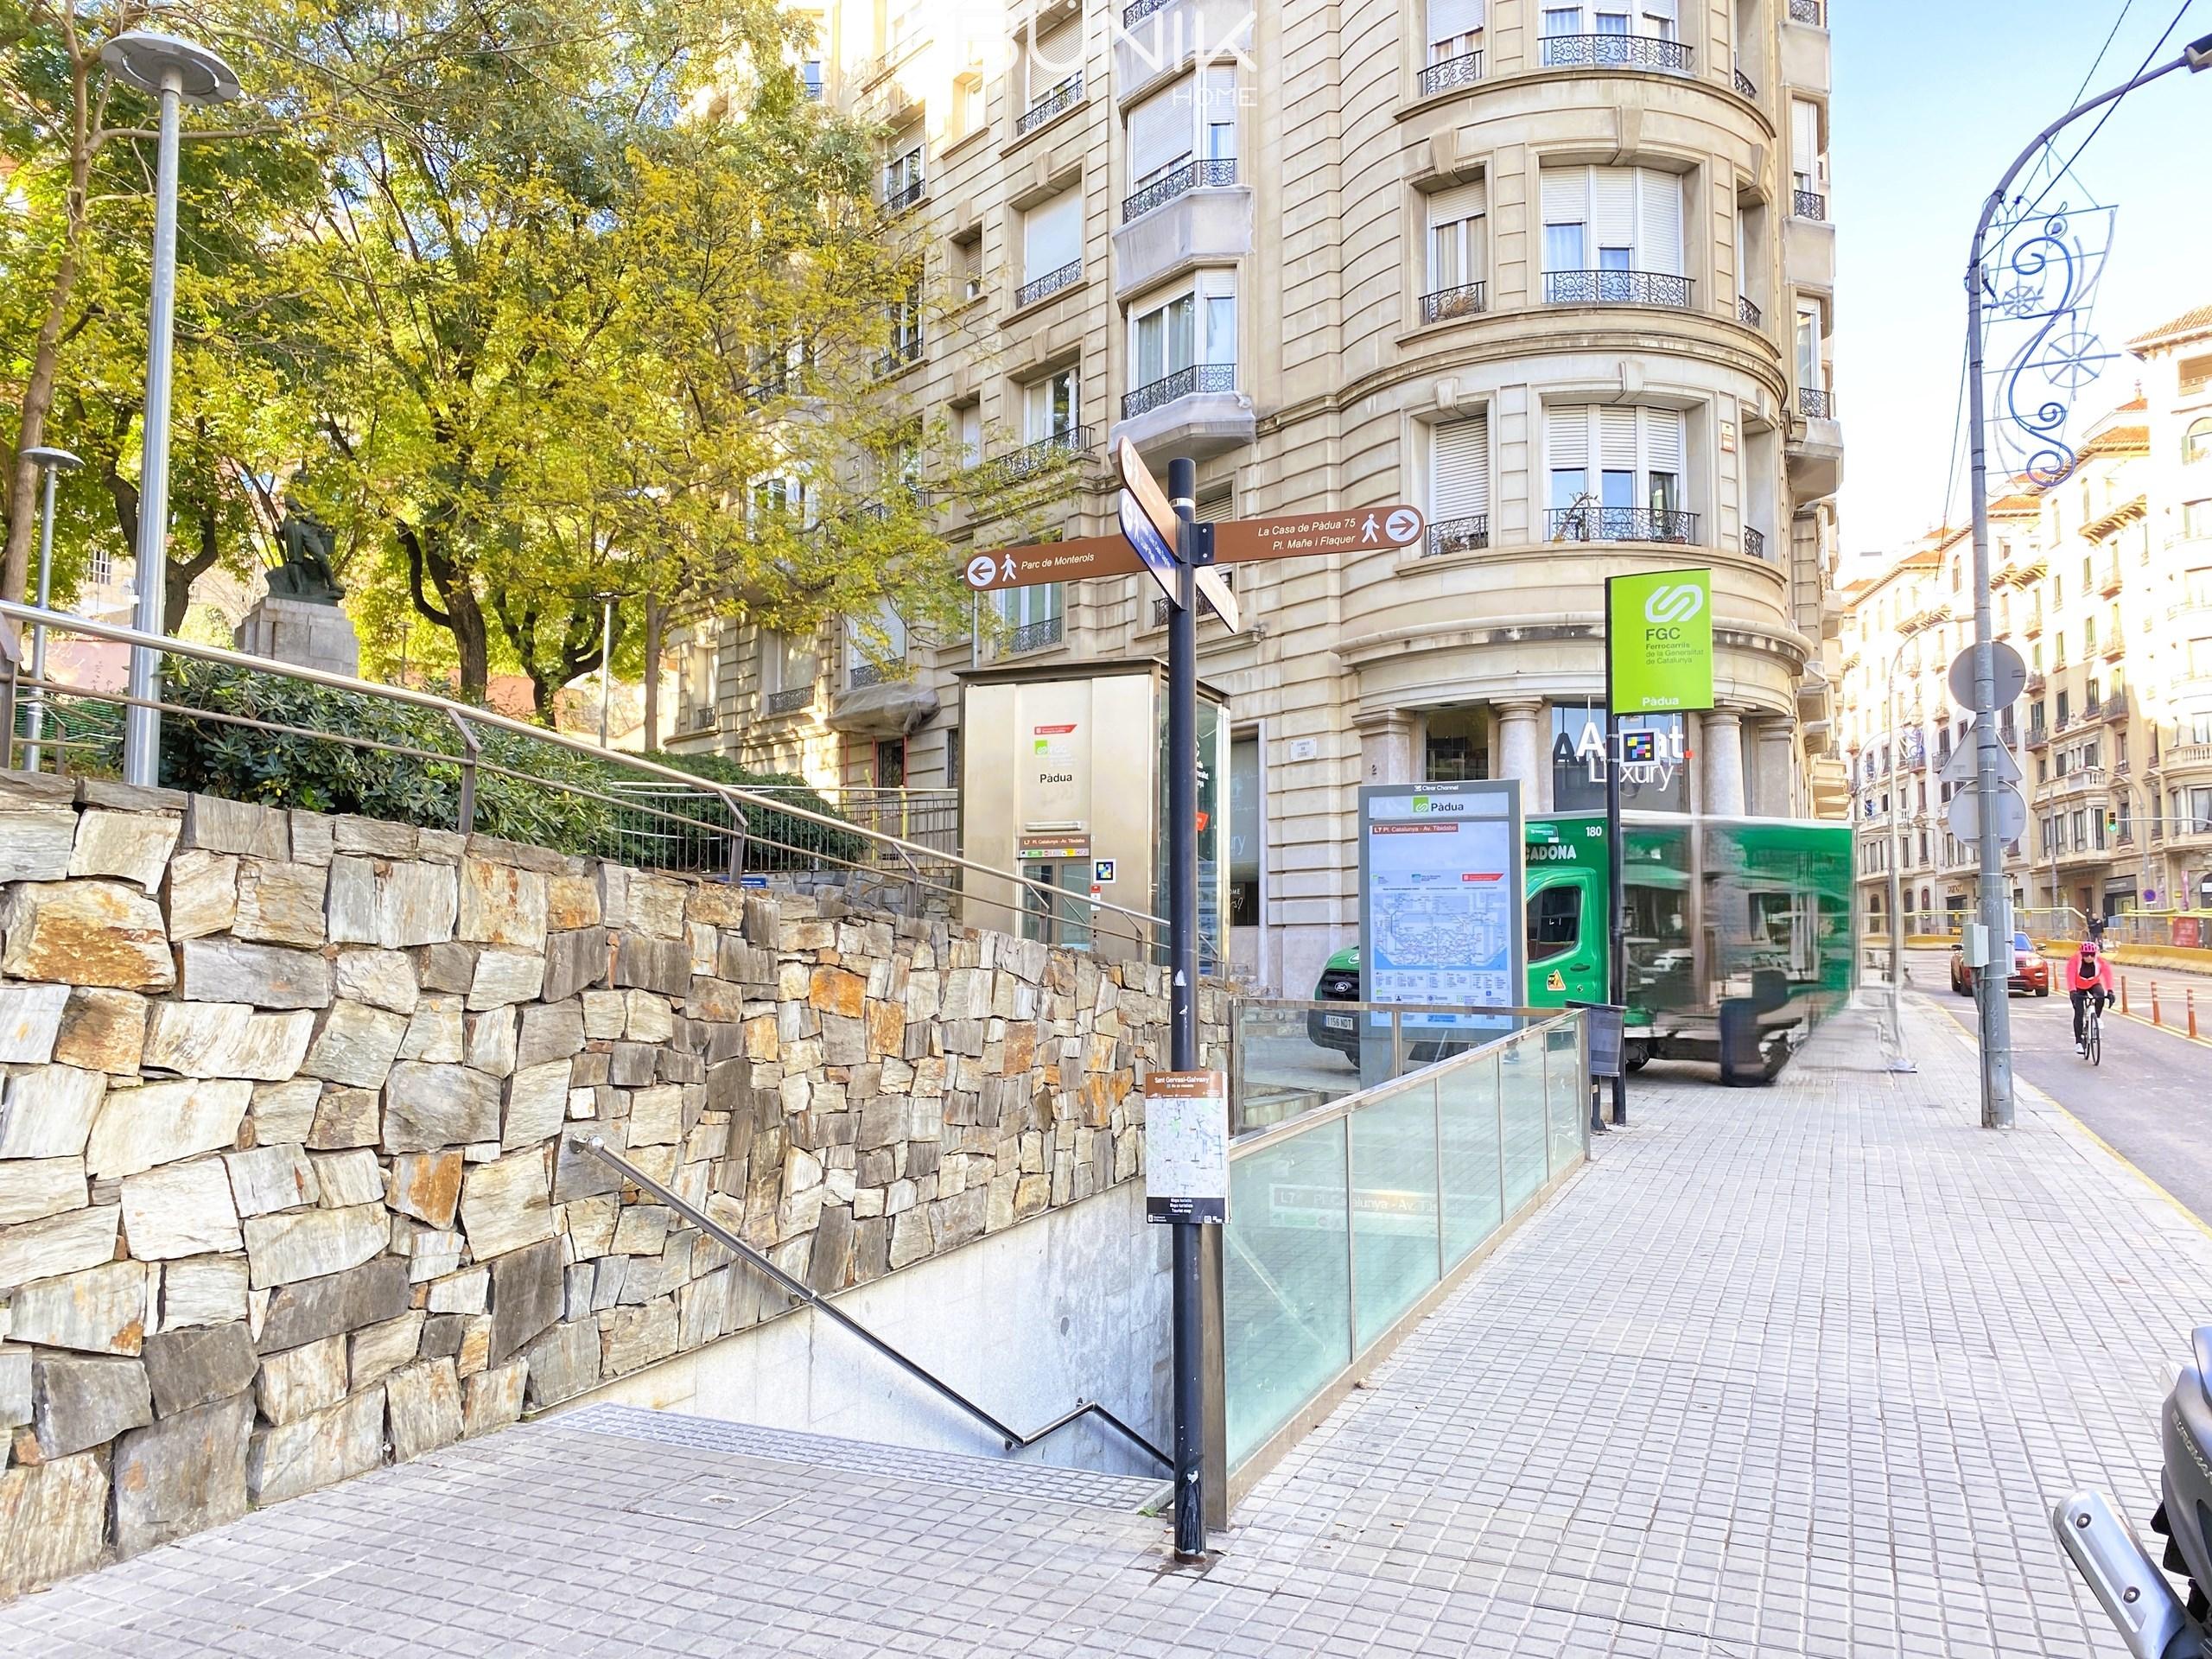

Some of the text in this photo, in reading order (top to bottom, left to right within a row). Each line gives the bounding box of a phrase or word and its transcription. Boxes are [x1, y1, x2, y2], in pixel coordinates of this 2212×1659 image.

[1257, 518, 1356, 537] La Casa de Pàdua 75
[1272, 541, 1284, 550] Pl.
[1287, 538, 1313, 550] Mañe
[1320, 535, 1356, 547] Flaquer
[1020, 552, 1095, 570] Parc de Monterols
[1645, 626, 1681, 641] FGC
[1645, 642, 1690, 651] Ferrocarrils
[1642, 696, 1680, 707] Pàdua
[1039, 772, 1073, 784] Pàdua
[1588, 757, 1675, 792] Lxury
[1431, 802, 1464, 812] Pàdua
[1585, 826, 1603, 837] 180
[1333, 1194, 1388, 1210] Caalunya
